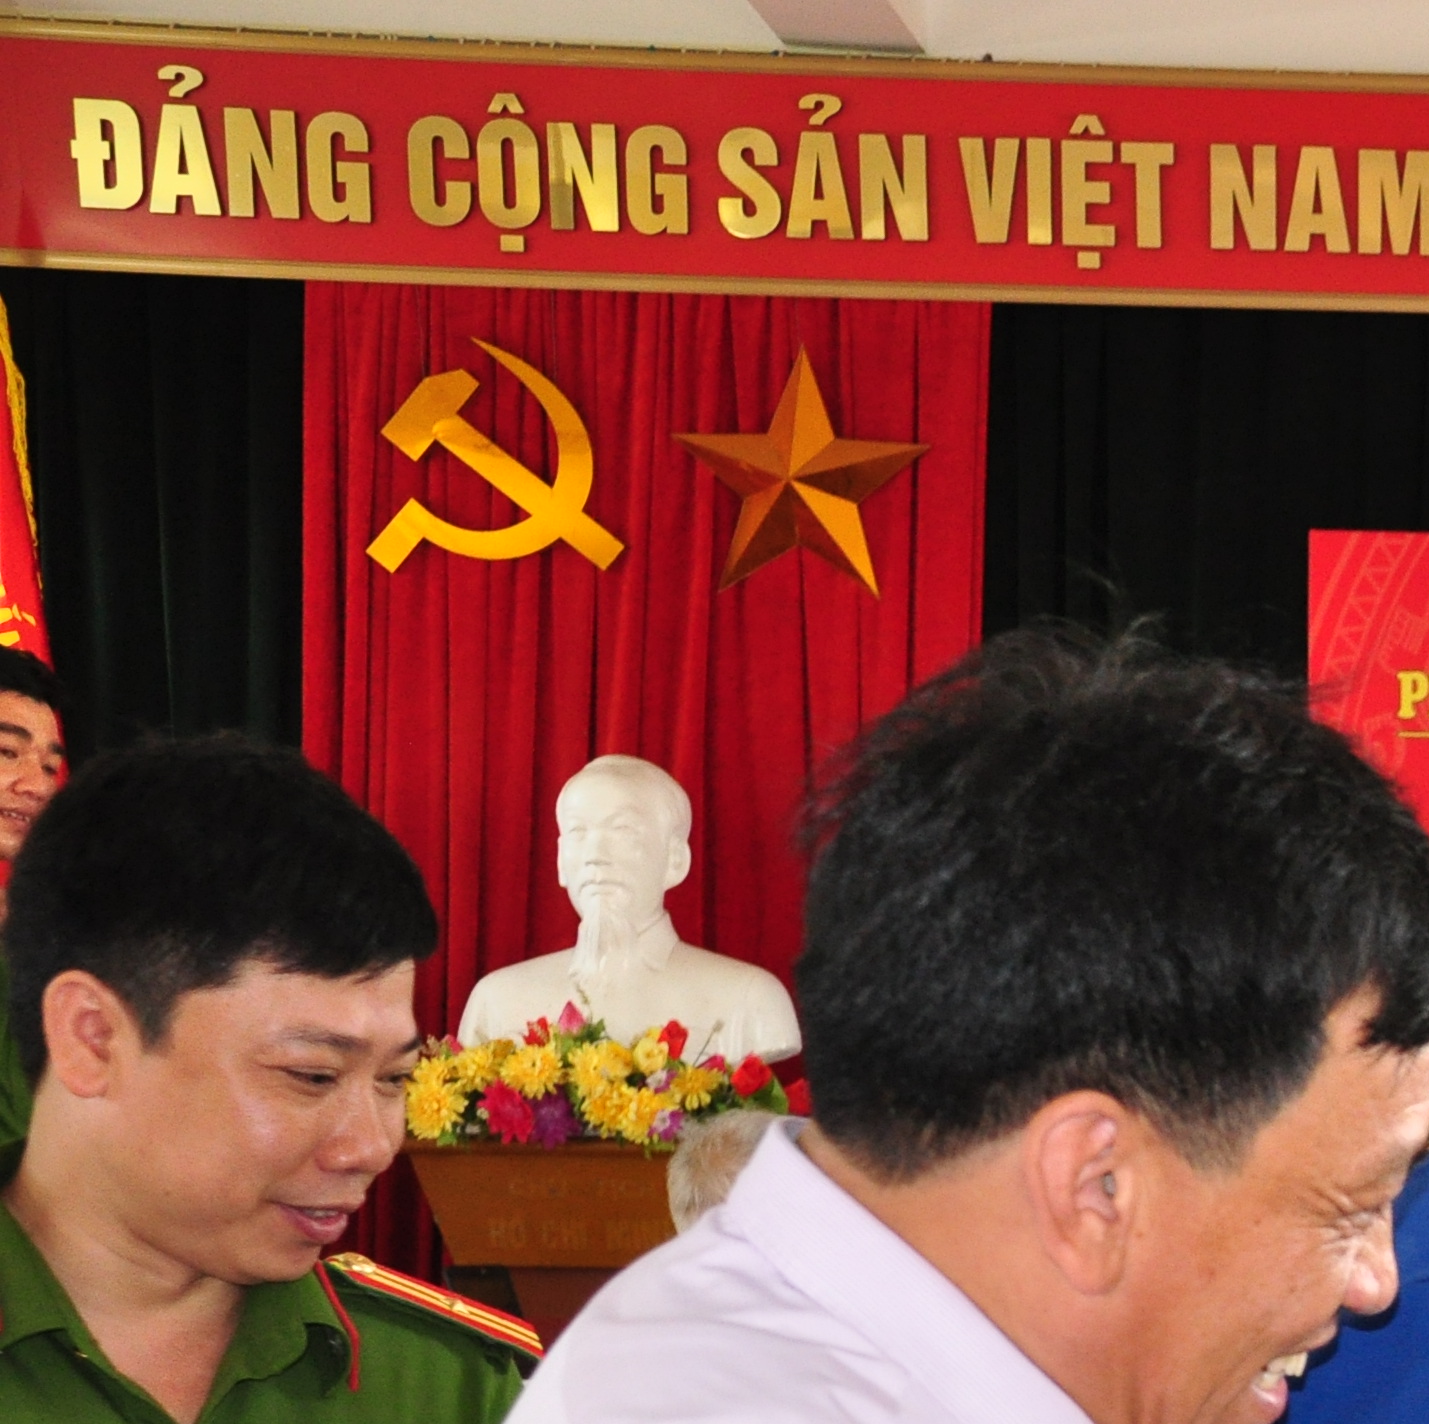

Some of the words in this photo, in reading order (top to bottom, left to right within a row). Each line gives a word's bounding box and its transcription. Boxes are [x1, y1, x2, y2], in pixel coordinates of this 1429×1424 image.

[69, 64, 375, 225] ĐẢNG
[406, 92, 690, 254] CỘNG
[717, 93, 930, 241] SẢN
[957, 113, 1175, 270] VIỆT
